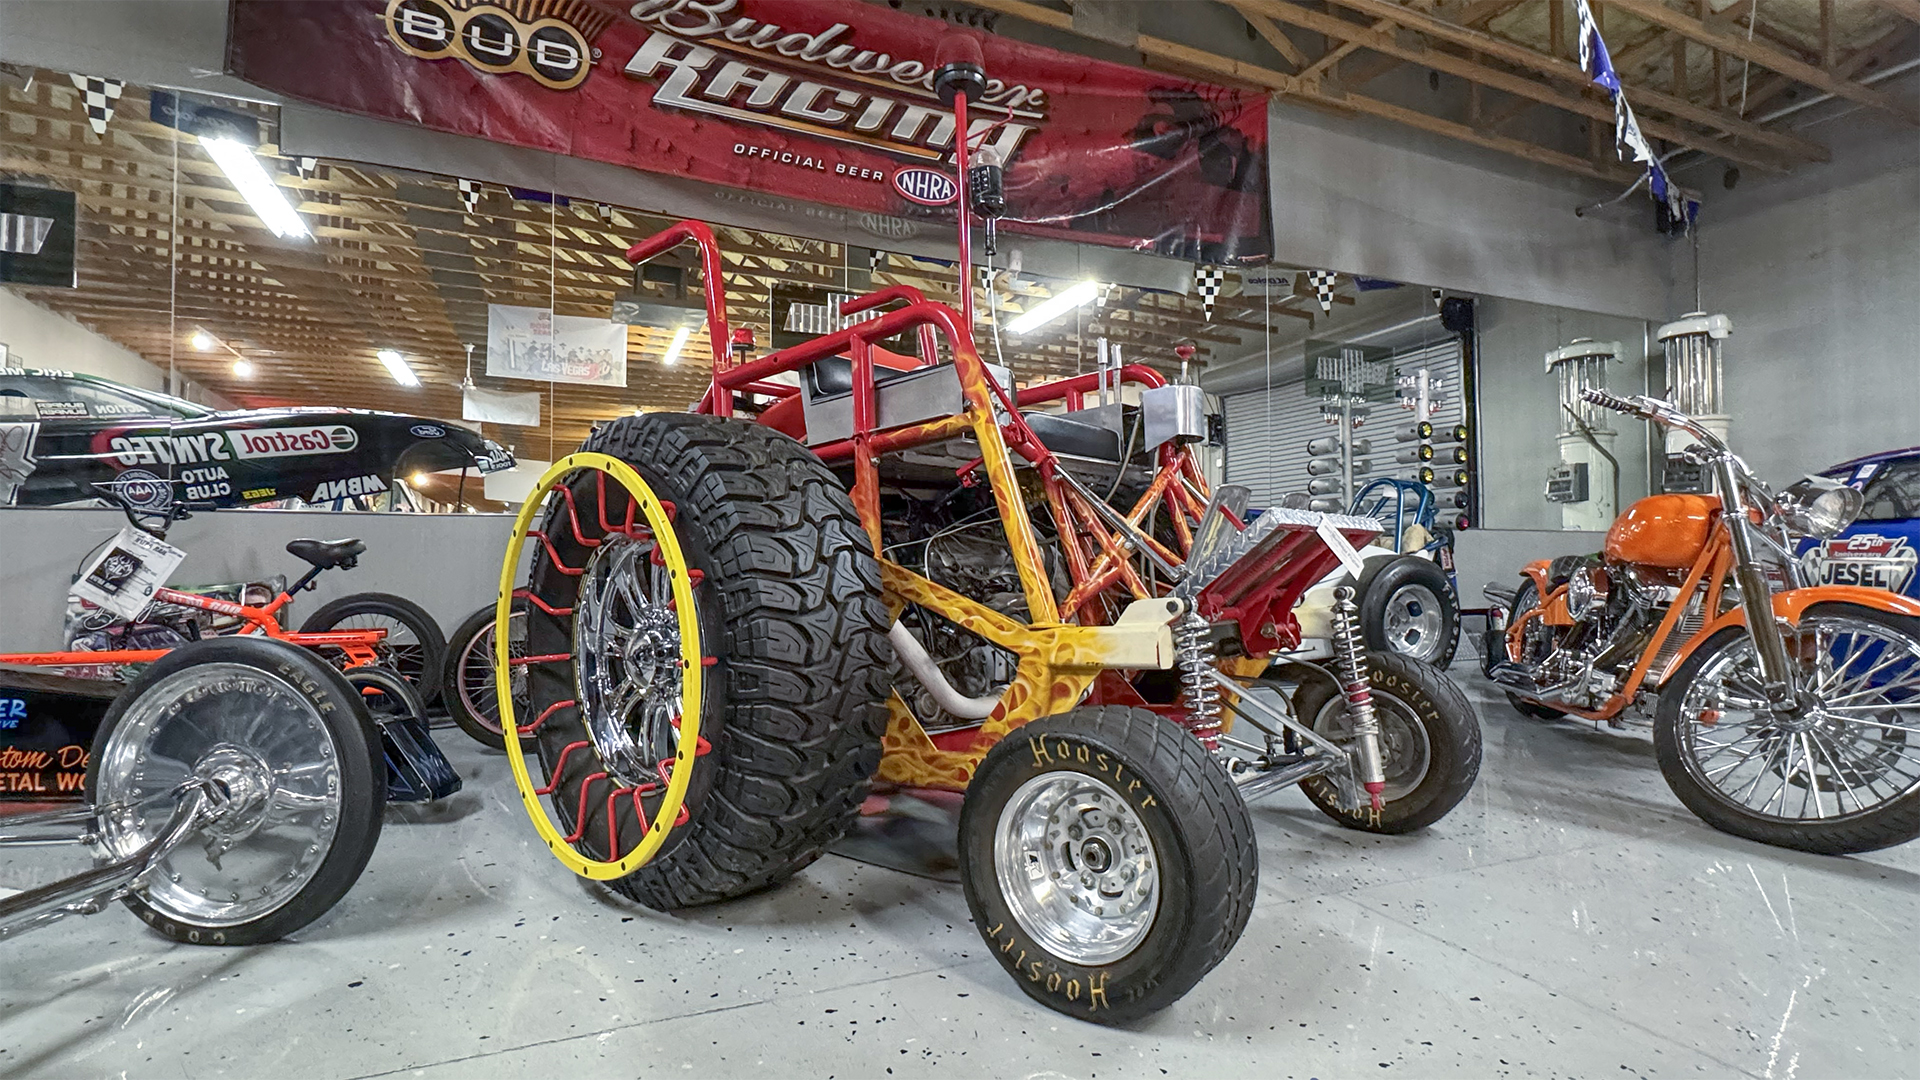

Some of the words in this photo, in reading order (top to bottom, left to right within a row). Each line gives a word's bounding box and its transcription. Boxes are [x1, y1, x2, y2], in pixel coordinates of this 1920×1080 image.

[402, 8, 579, 70] BUD
[624, 30, 1039, 166] RACING
[733, 142, 826, 171] OFFICIAL
[836, 162, 885, 182] BEER
[898, 168, 956, 200] NHRA
[1847, 534, 1883, 551] 25th
[1821, 562, 1888, 588] JESEL
[277, 660, 337, 716] EAGLE
[1371, 668, 1441, 721] oosier
